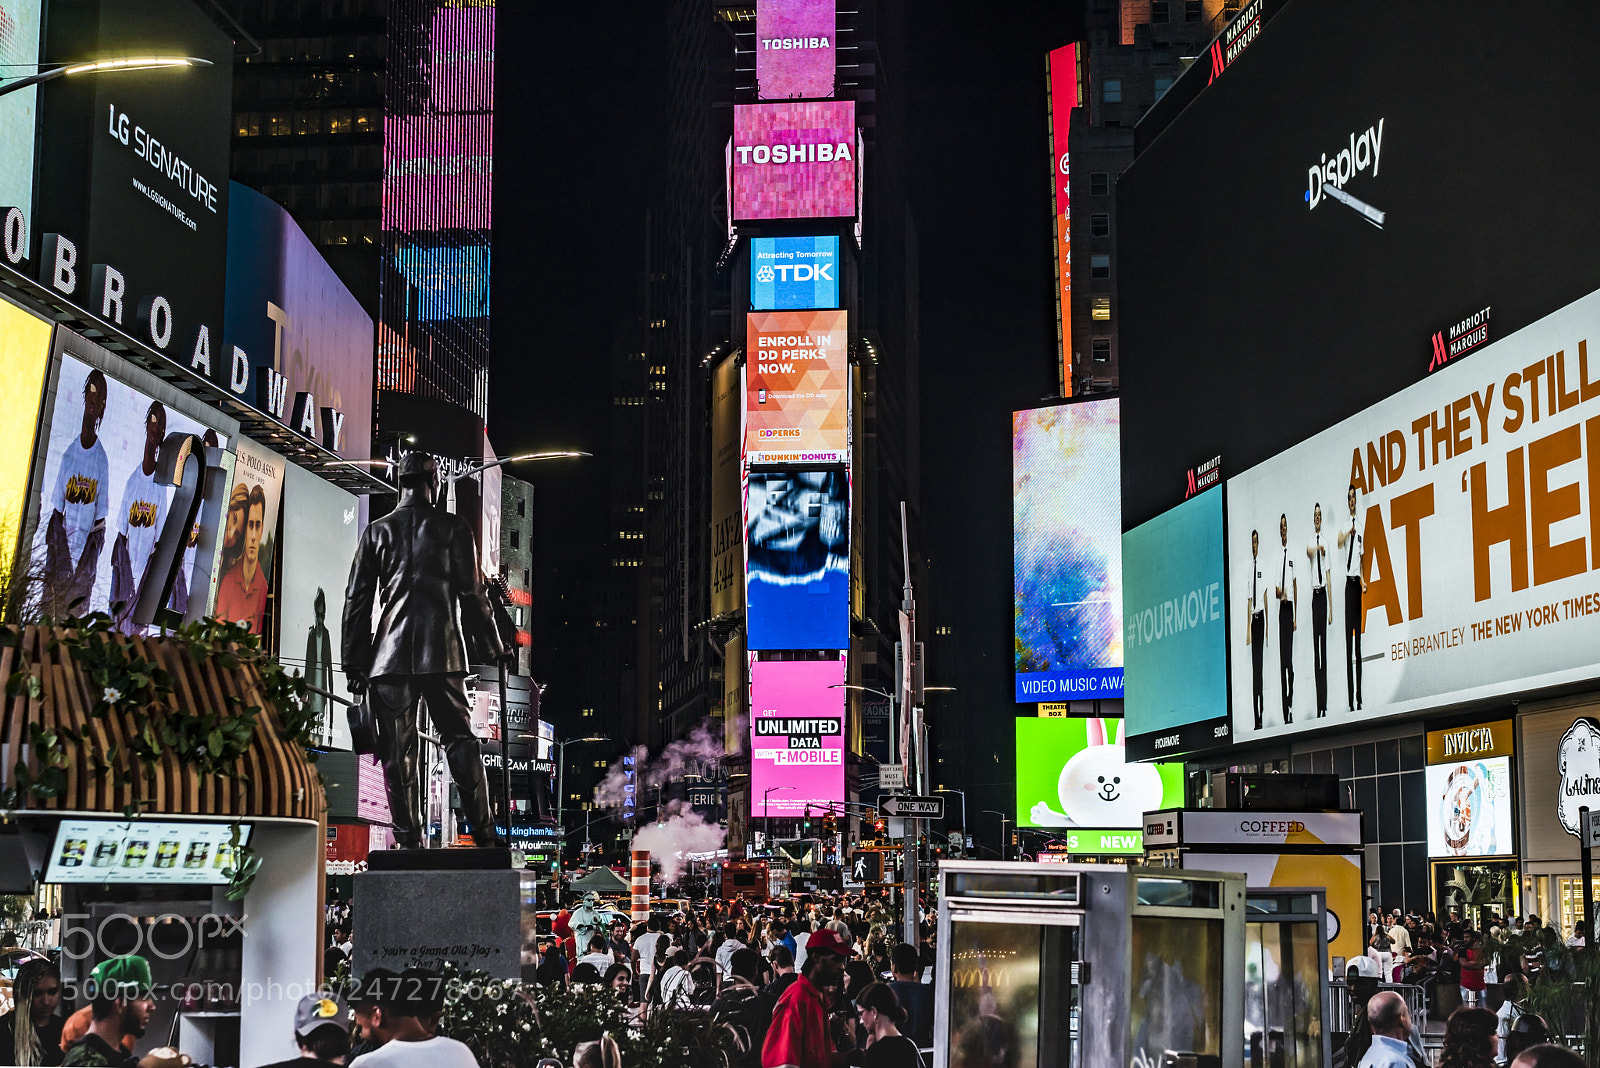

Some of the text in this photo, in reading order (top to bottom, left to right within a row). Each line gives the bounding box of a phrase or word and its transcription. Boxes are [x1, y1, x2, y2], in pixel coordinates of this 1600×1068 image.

[1226, 0, 1263, 45] MARRIOTT
[762, 37, 830, 50] TOSHIBA
[1227, 20, 1260, 63] MARQUIS
[109, 104, 218, 214] LG SIGNATURE
[736, 143, 852, 164] TOSHIBA
[1309, 117, 1384, 211] Display
[757, 250, 833, 260] Attracting Tomorrow
[774, 263, 833, 281] TDK
[1450, 306, 1491, 339] MARRIOTT
[53, 234, 345, 452] BROADWAY
[758, 335, 832, 347] ENROLL IN
[1450, 328, 1486, 356] MARQUIS
[758, 349, 827, 361] DD PERKS
[758, 363, 796, 375] NOW.
[1350, 338, 1600, 497] AND THEY STILL
[246, 454, 262, 472] POLO
[801, 453, 837, 461] DONUTS
[1354, 482, 1435, 635] AT
[713, 554, 734, 594] 4:44
[1127, 582, 1220, 649] #YOURMOVE
[1390, 592, 1600, 662] BEN BRANTLEY THE NEW YORK TIMES
[1021, 676, 1124, 694] VIDEO MUSIC AWA
[763, 709, 777, 717] GET
[757, 719, 839, 735] UNLIMITED
[790, 737, 820, 748] DATA
[1443, 728, 1494, 756] INVICTA
[756, 750, 839, 763] WITH T-MOBILE
[897, 802, 937, 812] ONE WAY
[499, 826, 545, 837] Bukingham
[1240, 820, 1305, 833] COFFEED
[1100, 836, 1137, 848] NEW
[410, 947, 417, 955] a
[419, 945, 448, 957] Grand
[450, 944, 468, 956] Old
